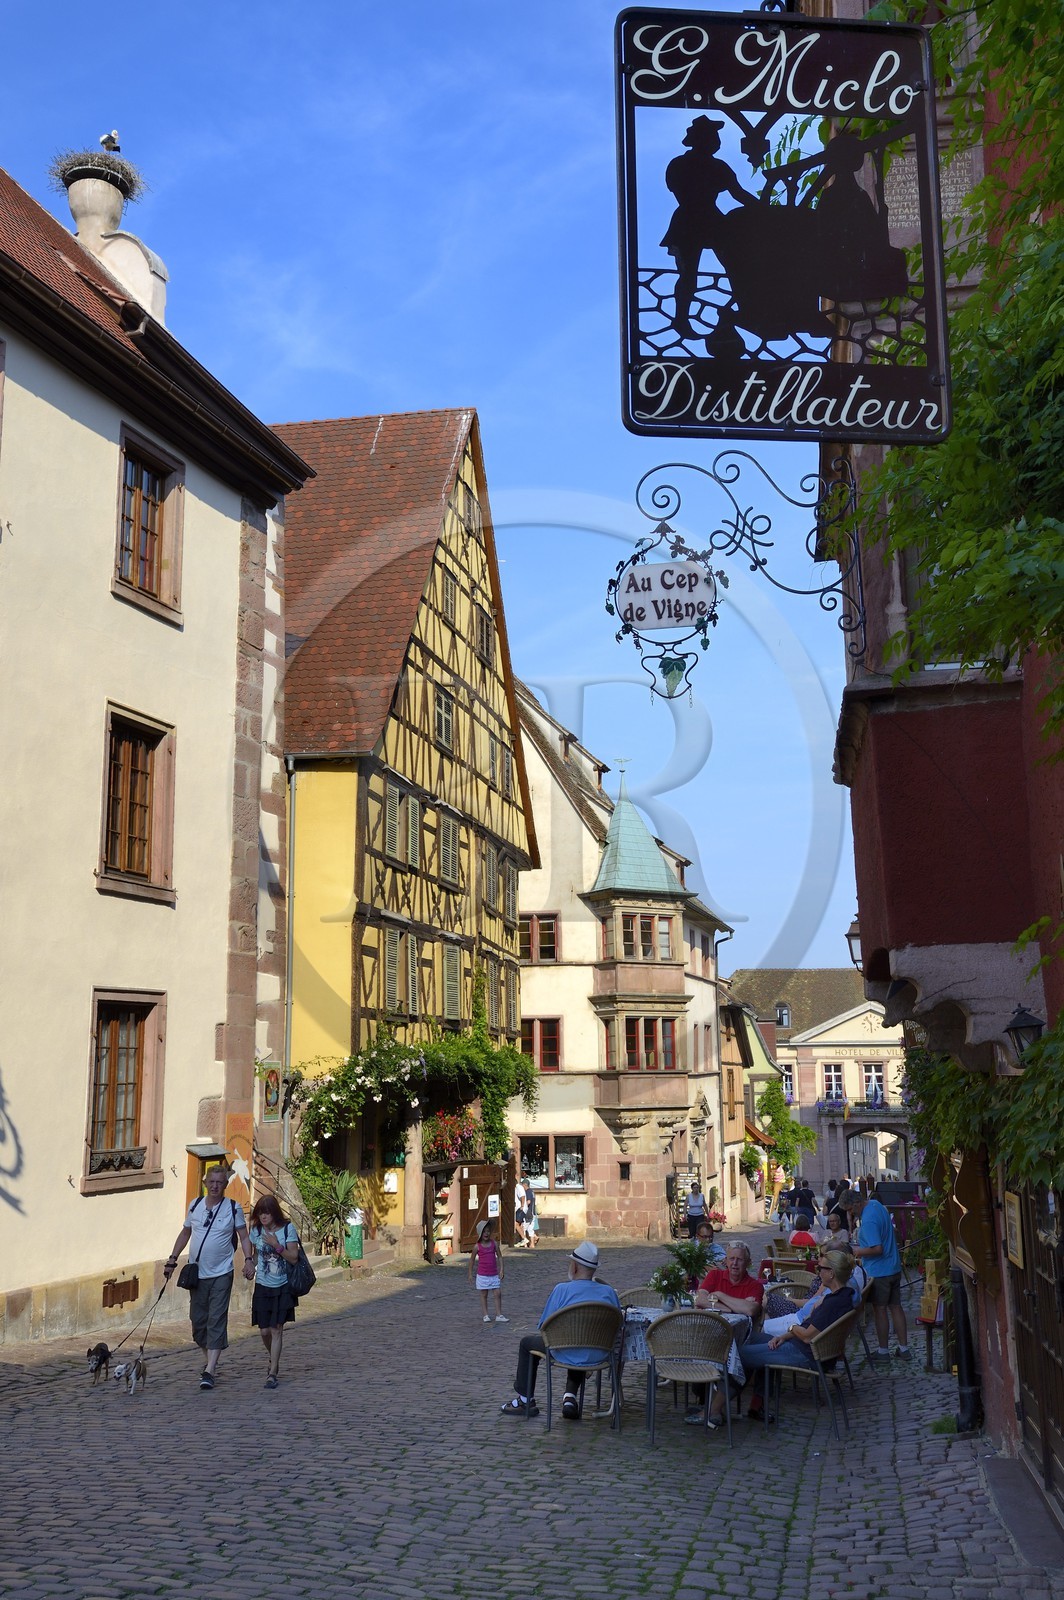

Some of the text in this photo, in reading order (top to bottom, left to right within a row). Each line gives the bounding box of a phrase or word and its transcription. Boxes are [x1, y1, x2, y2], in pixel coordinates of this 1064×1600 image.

[630, 25, 920, 114] G. Miclo
[634, 361, 942, 430] Distillateur
[625, 569, 699, 593] Au Cep
[623, 598, 708, 623] de Vigne
[834, 1048, 864, 1056] HOTEL
[869, 1048, 881, 1056] DE
